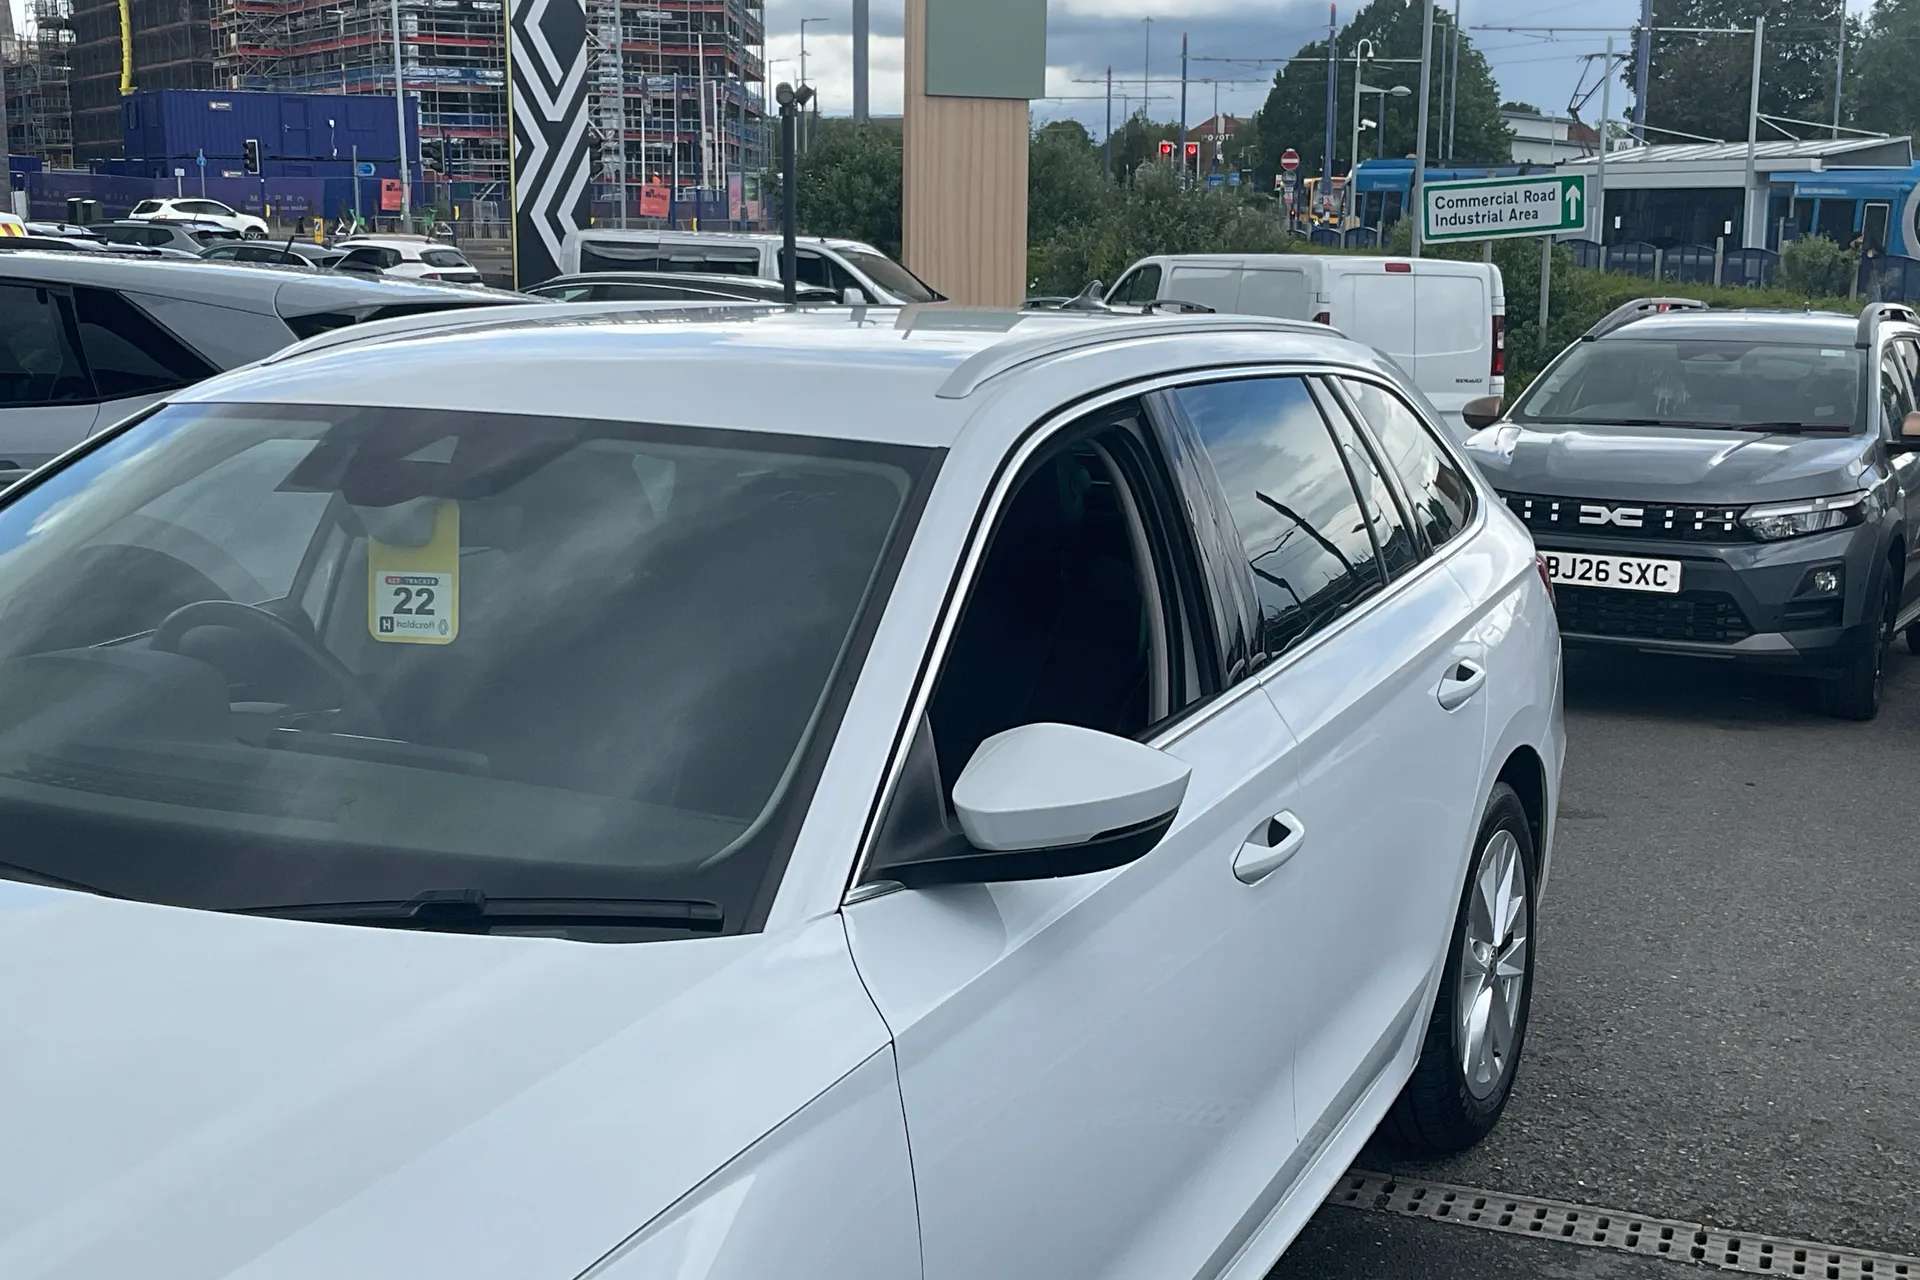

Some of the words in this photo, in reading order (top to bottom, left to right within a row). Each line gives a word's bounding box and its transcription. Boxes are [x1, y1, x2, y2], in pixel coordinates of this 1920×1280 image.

[1435, 191, 1519, 210] Commercial
[1524, 188, 1556, 203] Road
[1435, 209, 1503, 227] Industrial
[1508, 208, 1539, 222] Area
[1546, 556, 1610, 582] BJ26
[1618, 562, 1668, 587] SXC
[393, 587, 435, 616] 22
